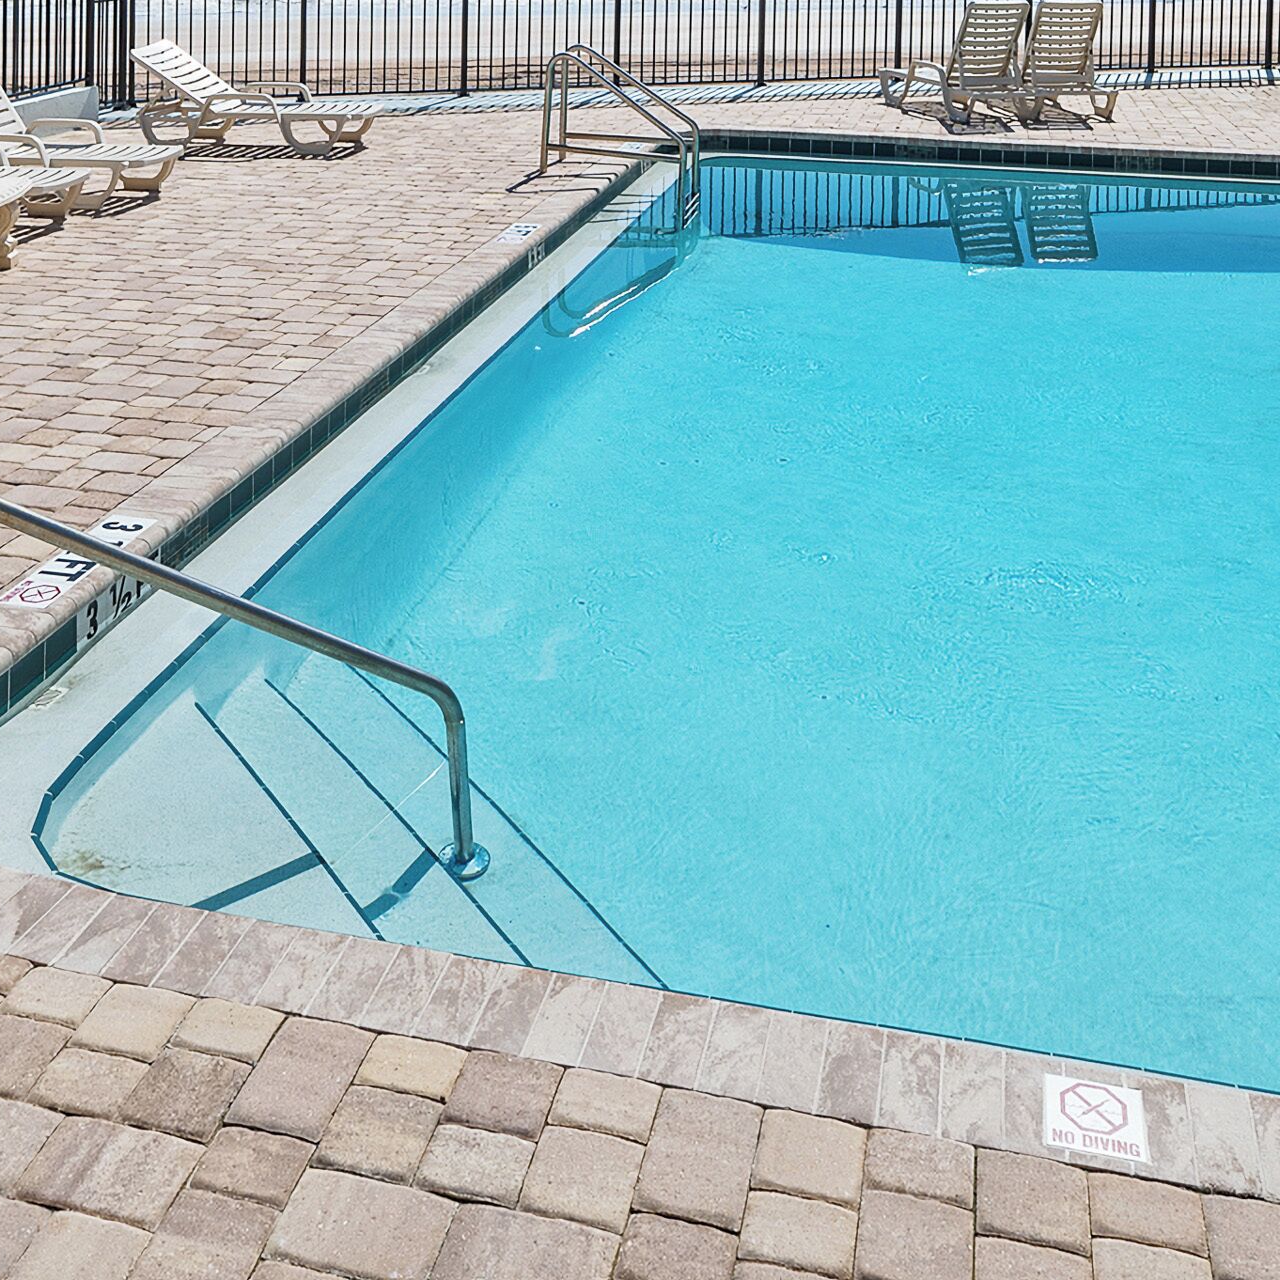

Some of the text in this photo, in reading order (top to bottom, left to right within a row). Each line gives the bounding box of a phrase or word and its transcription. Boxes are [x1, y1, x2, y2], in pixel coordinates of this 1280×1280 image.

[102, 521, 143, 532] 3
[38, 557, 97, 582] FT
[86, 599, 99, 640] 3
[1051, 1128, 1141, 1158] NO DIVING
